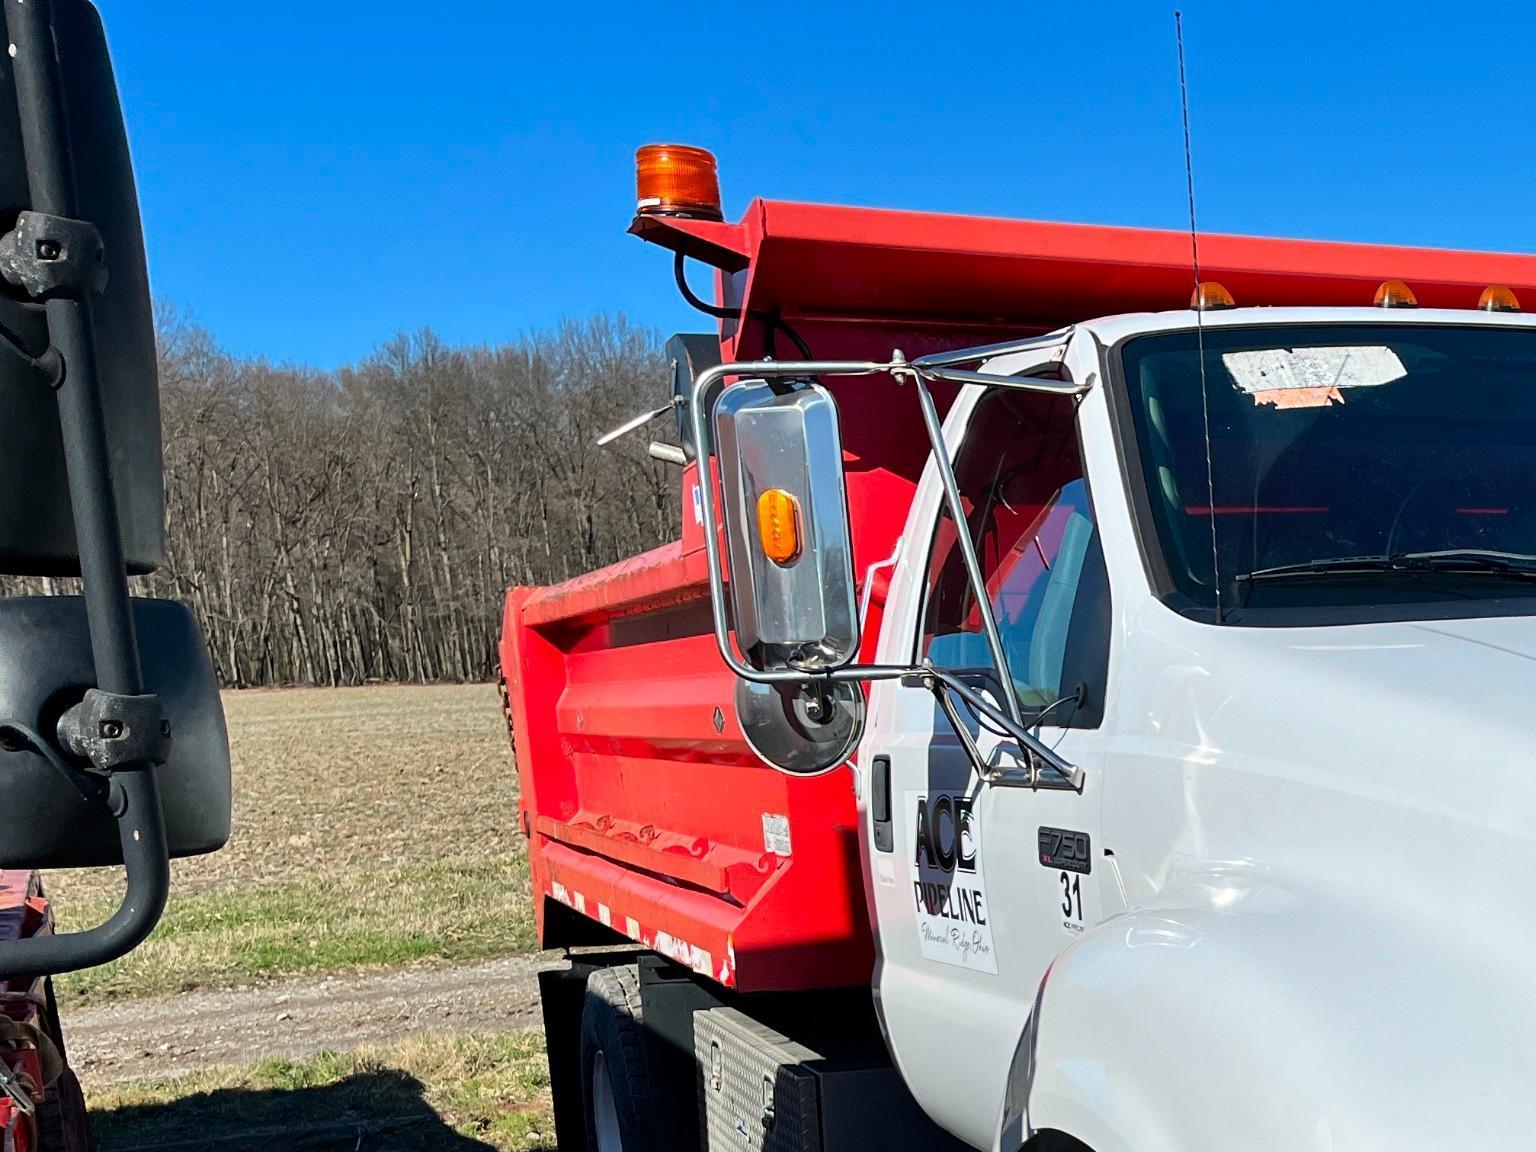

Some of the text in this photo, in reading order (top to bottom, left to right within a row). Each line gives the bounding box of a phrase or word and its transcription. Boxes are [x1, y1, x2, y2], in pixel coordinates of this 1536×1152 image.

[915, 793, 977, 874] ACE
[914, 880, 986, 926] PIPELINE
[1060, 871, 1082, 920] 31
